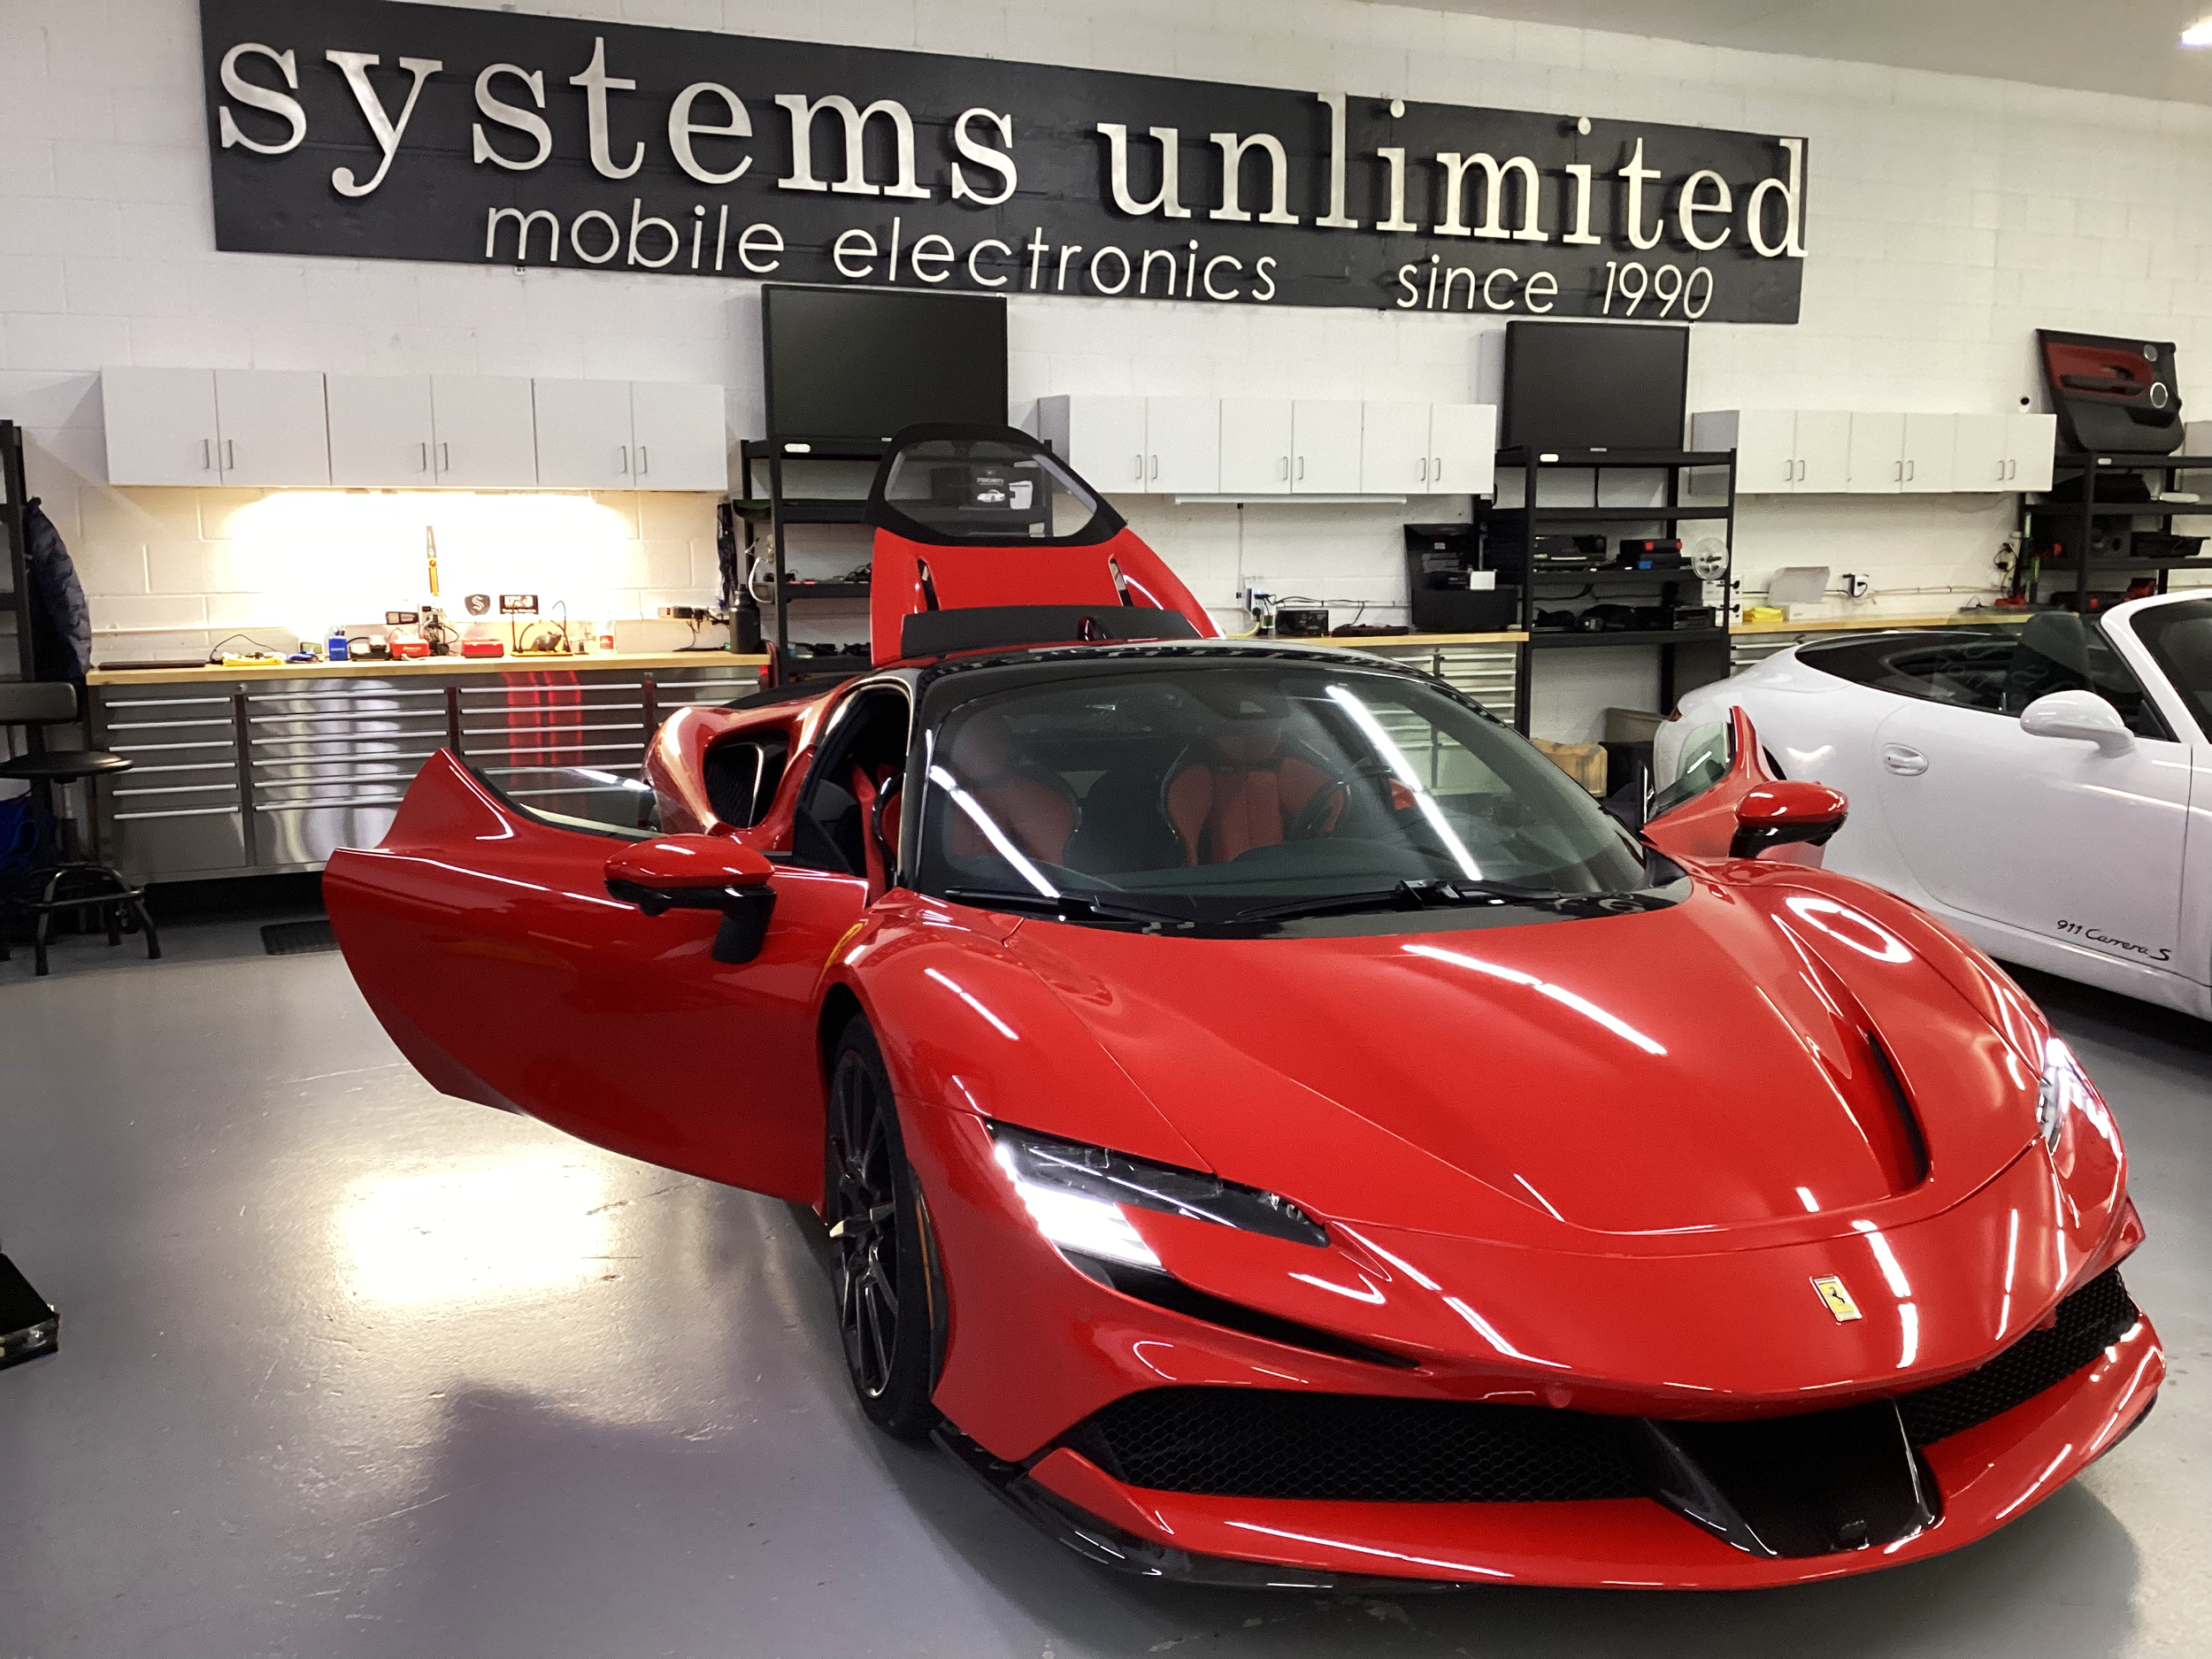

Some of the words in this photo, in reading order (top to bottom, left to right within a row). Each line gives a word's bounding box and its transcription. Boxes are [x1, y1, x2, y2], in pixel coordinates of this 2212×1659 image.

[219, 36, 1018, 204] systems
[1097, 91, 1808, 257] unlimited
[485, 197, 785, 273] mobile
[833, 216, 1277, 301] electronics
[1396, 255, 1558, 314] since
[1602, 260, 1714, 319] 1990
[2057, 919, 2083, 934] 911
[2085, 928, 2150, 956] Carrera
[2148, 948, 2171, 962] S
